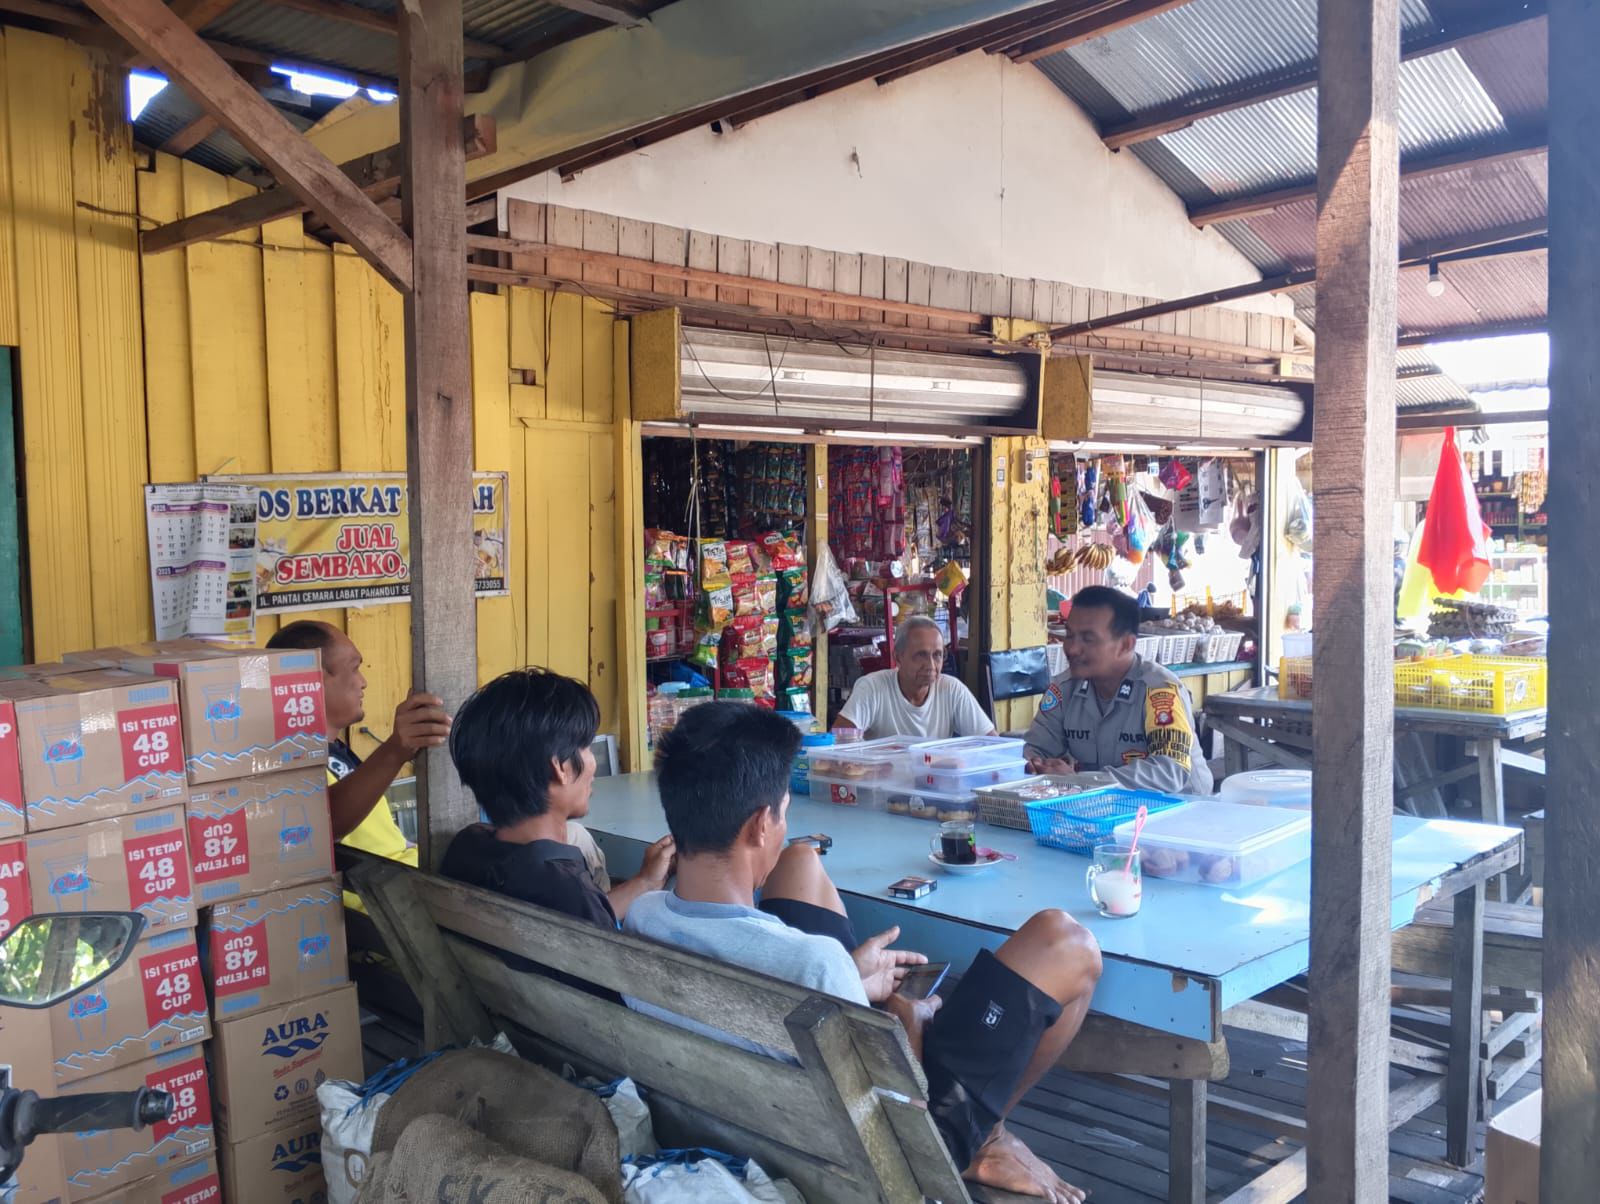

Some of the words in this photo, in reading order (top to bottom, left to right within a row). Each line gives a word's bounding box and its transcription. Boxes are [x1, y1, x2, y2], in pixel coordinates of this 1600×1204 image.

[258, 489, 290, 518] OS
[296, 487, 401, 517] BERKAT
[338, 527, 398, 550] JUAL
[277, 553, 407, 582] SEMBAKO,
[272, 593, 301, 605] PANTAI
[303, 590, 334, 603] CEMARA
[335, 588, 359, 600] LABAT
[360, 585, 400, 598] PAHANDUT
[401, 584, 410, 594] SE
[274, 685, 288, 696] ISI
[290, 681, 321, 694] TETAP
[283, 695, 315, 716] 48
[122, 720, 138, 733] ISI
[141, 715, 177, 729] TETAP
[287, 714, 316, 728] CUP
[132, 731, 169, 753] 48
[1064, 728, 1090, 740] UTUT
[138, 752, 170, 767] CUP
[203, 822, 233, 838] CUP
[128, 849, 145, 862] ISI
[147, 840, 182, 857] TETAP
[204, 836, 238, 857] 48
[139, 857, 174, 881] 48
[195, 858, 228, 873] TETAP
[232, 854, 246, 866] ISI
[144, 877, 176, 894] CUP
[224, 935, 253, 951] CUP
[144, 966, 160, 980] ISI
[163, 955, 199, 974] TETAP
[225, 948, 257, 970] 48
[216, 971, 249, 986] TETAP
[252, 966, 266, 978] ISI
[155, 973, 190, 997] 48
[162, 992, 192, 1011] CUP
[262, 1012, 329, 1047] AURA
[169, 1070, 204, 1089] TETAP
[168, 1106, 197, 1125] CUP
[271, 1131, 321, 1162] AUR
